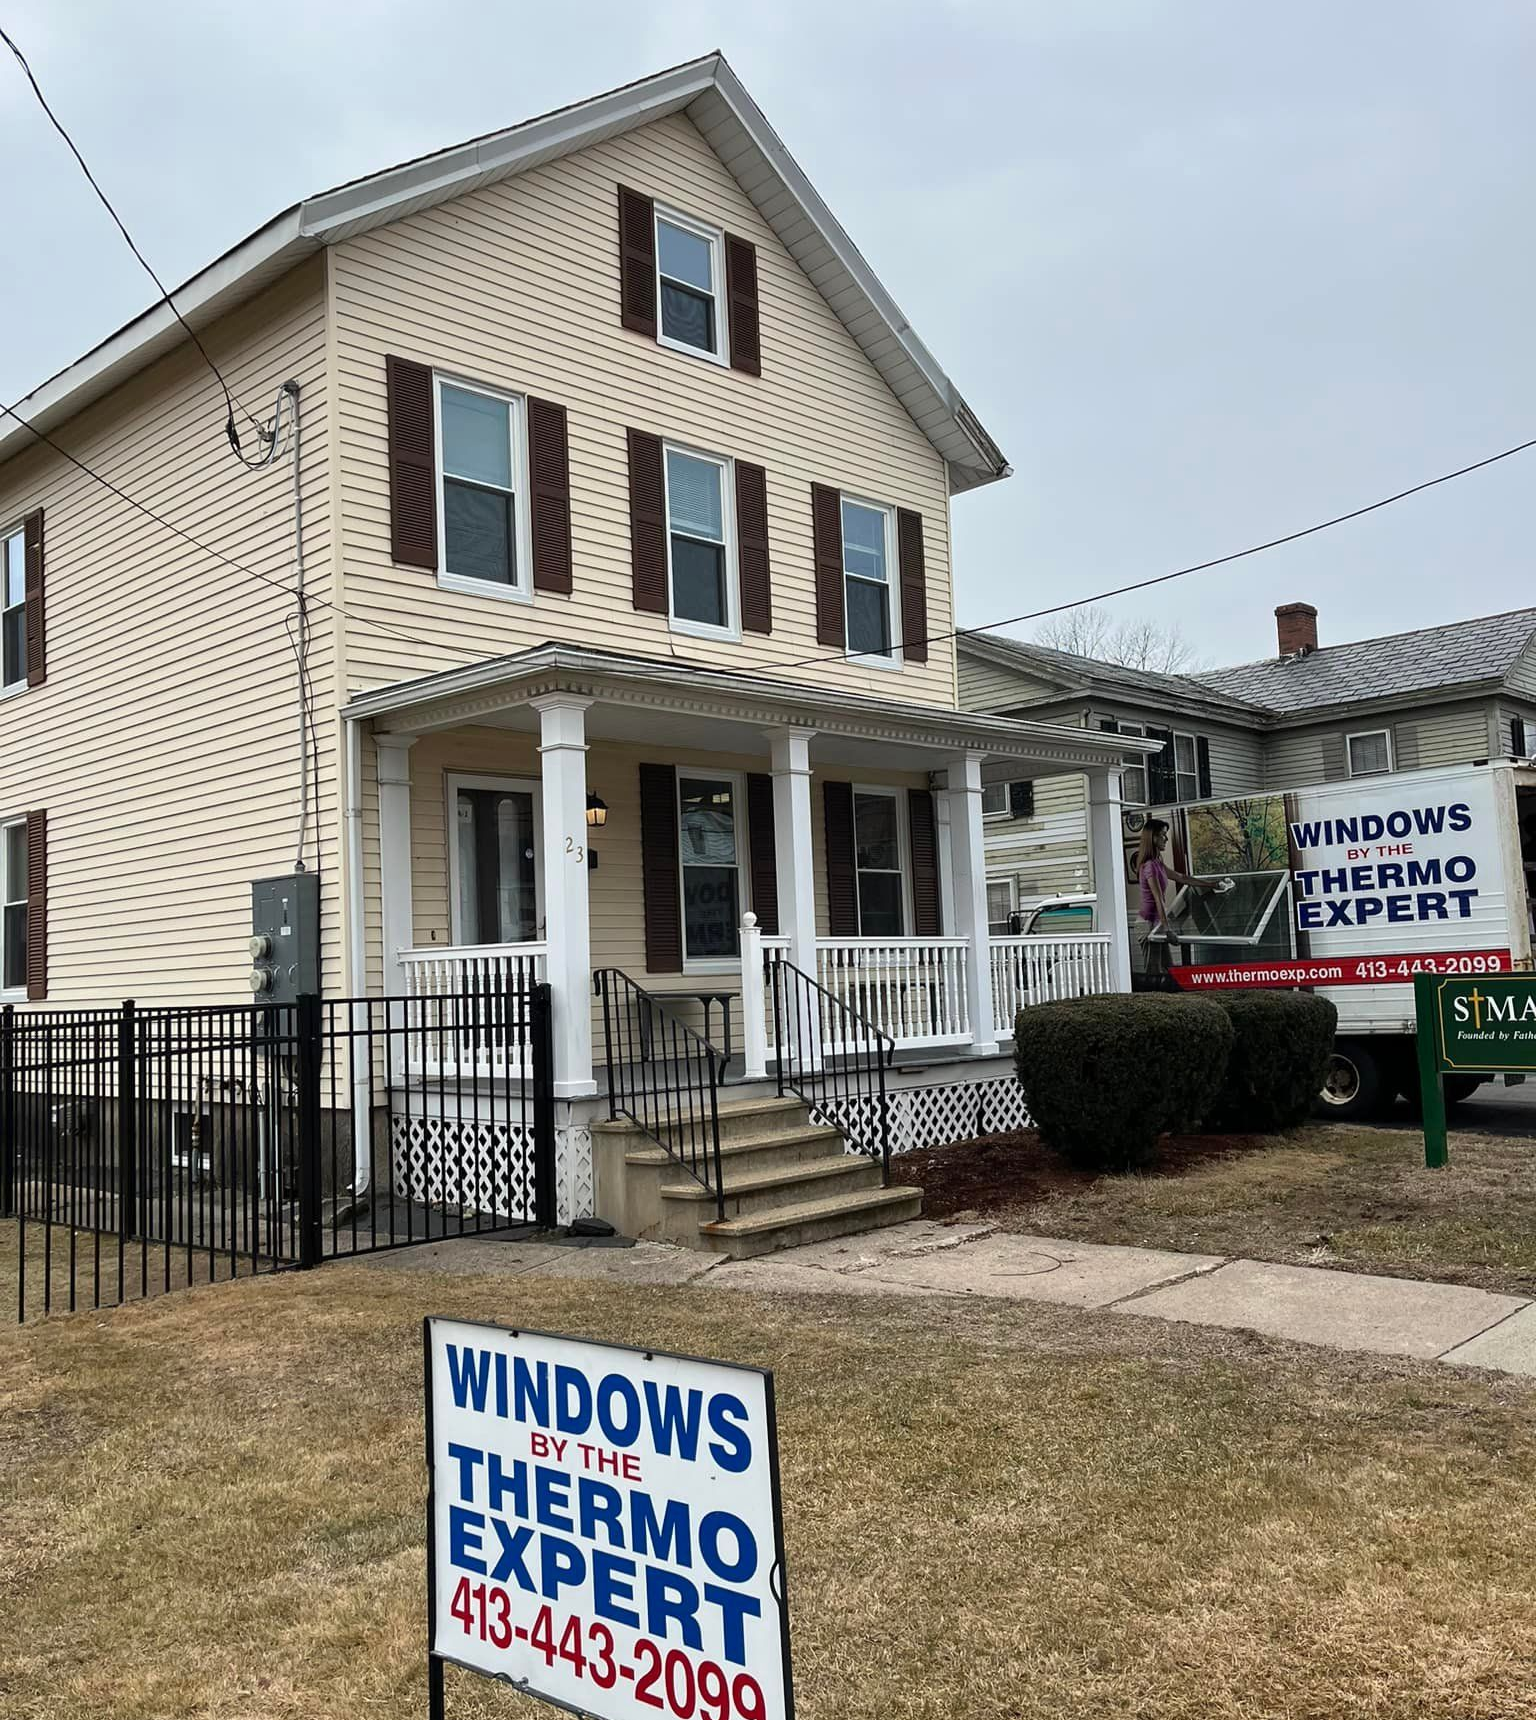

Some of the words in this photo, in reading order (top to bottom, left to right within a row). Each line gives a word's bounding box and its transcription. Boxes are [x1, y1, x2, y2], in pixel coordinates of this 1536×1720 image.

[1291, 803, 1473, 849] WINDOWS
[565, 836, 584, 863] 23
[1347, 847, 1371, 860] BY
[1375, 843, 1413, 857] THE
[1296, 855, 1477, 895] THERMO
[1298, 889, 1479, 928] EXPERT
[1191, 966, 1343, 984] www.thermoexp.com
[1355, 955, 1501, 979] 413-443-2099
[1457, 1030, 1495, 1040] Founded
[1499, 1030, 1510, 1041] by
[445, 1343, 752, 1474] WINDOWS
[530, 1431, 568, 1461] BY
[577, 1443, 642, 1482] THE
[448, 1442, 757, 1583] THERMO
[449, 1505, 761, 1667] EXPERT
[450, 1576, 766, 1720] 413-443-2099
